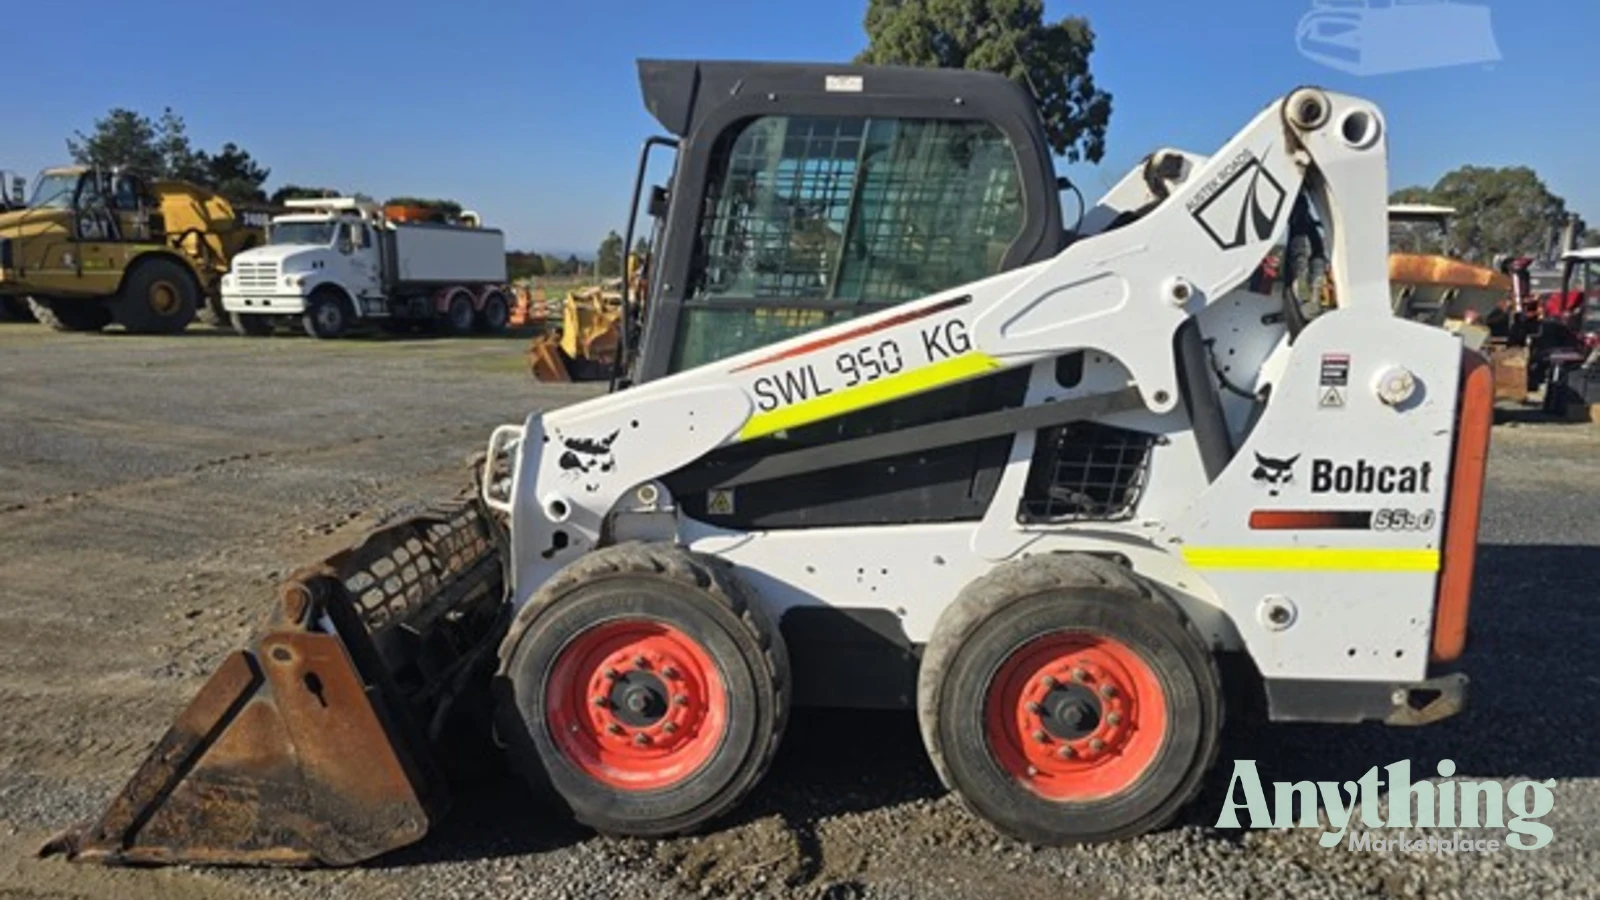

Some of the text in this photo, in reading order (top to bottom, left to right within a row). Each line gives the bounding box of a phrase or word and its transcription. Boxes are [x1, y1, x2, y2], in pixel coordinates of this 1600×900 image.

[753, 319, 972, 412] SWL 950 KG
[1310, 458, 1432, 494] Bobcat
